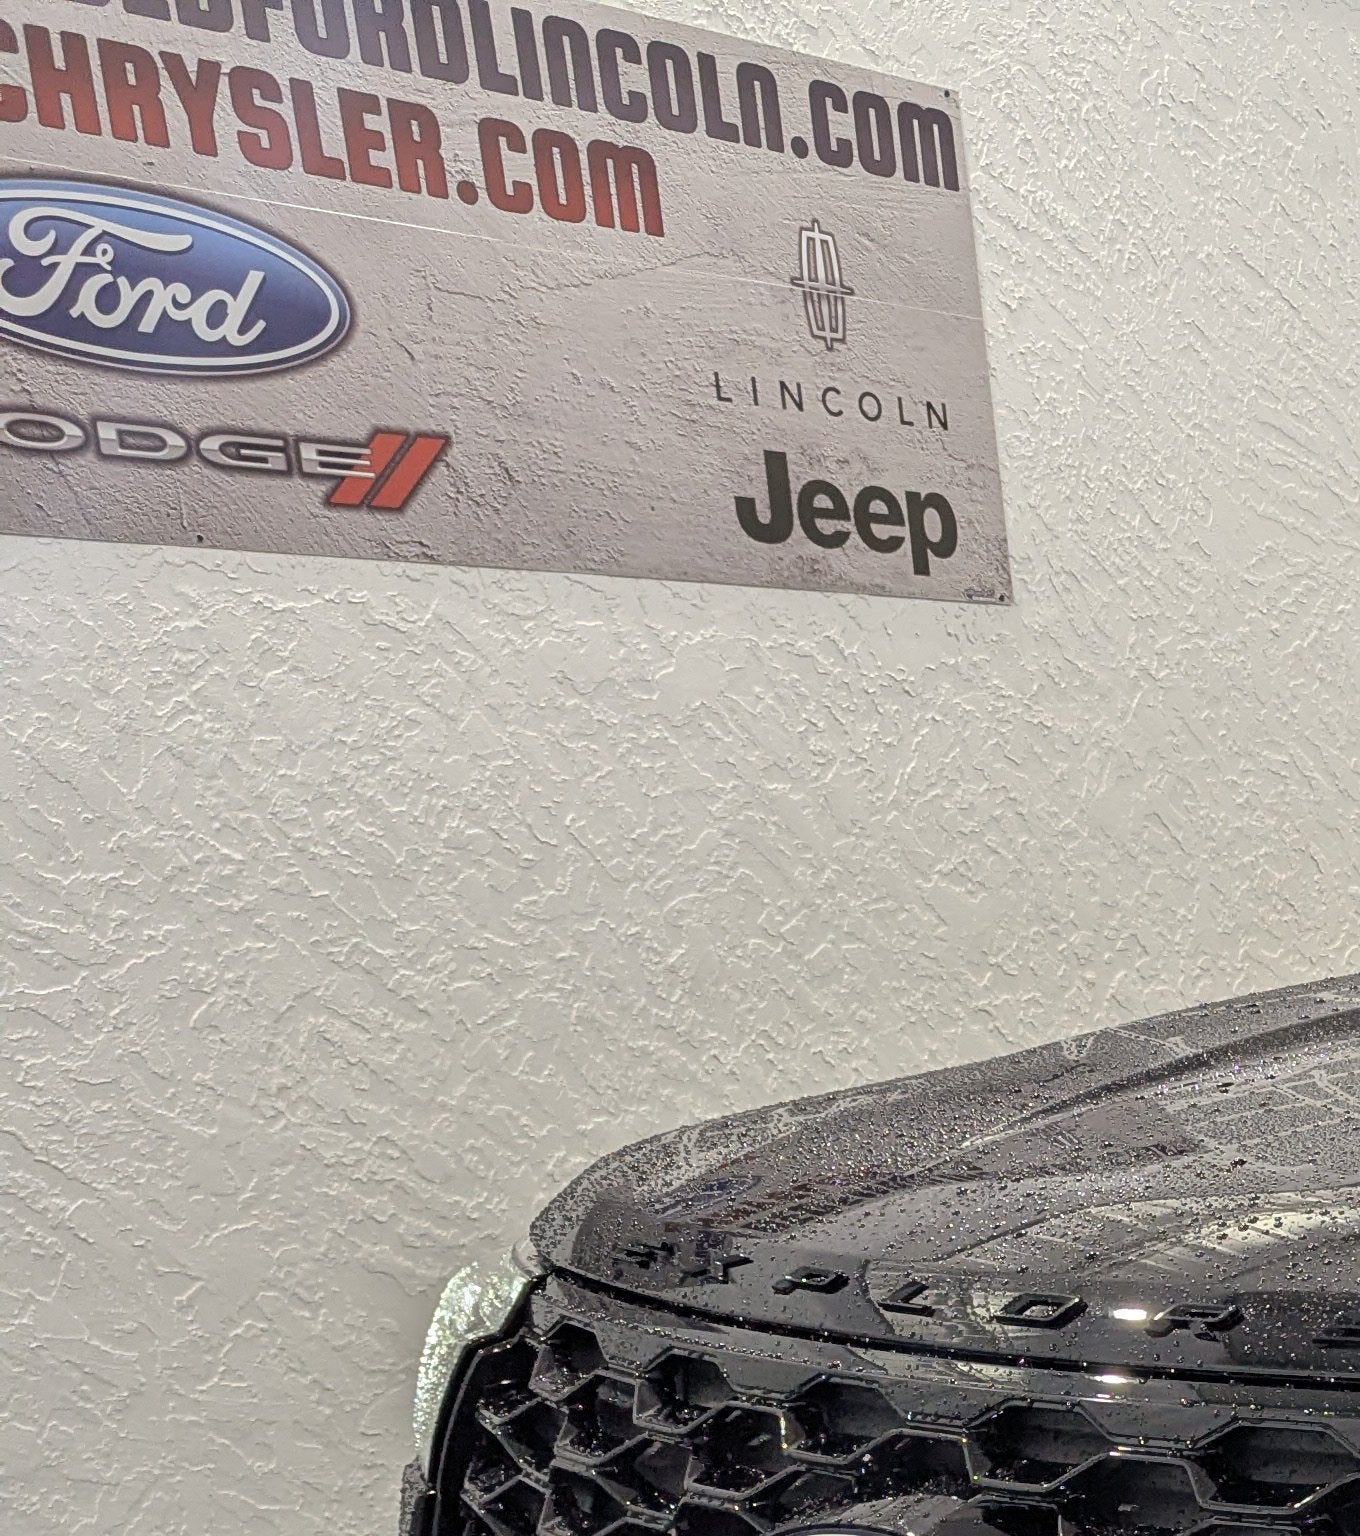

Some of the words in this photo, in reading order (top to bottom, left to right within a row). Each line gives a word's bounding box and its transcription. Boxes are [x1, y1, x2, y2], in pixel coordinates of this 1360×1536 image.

[85, 0, 959, 192] ORDLINCOLN.COM
[0, 206, 268, 347] Ford
[713, 371, 949, 431] LINCOLN
[733, 449, 958, 577] Jeep
